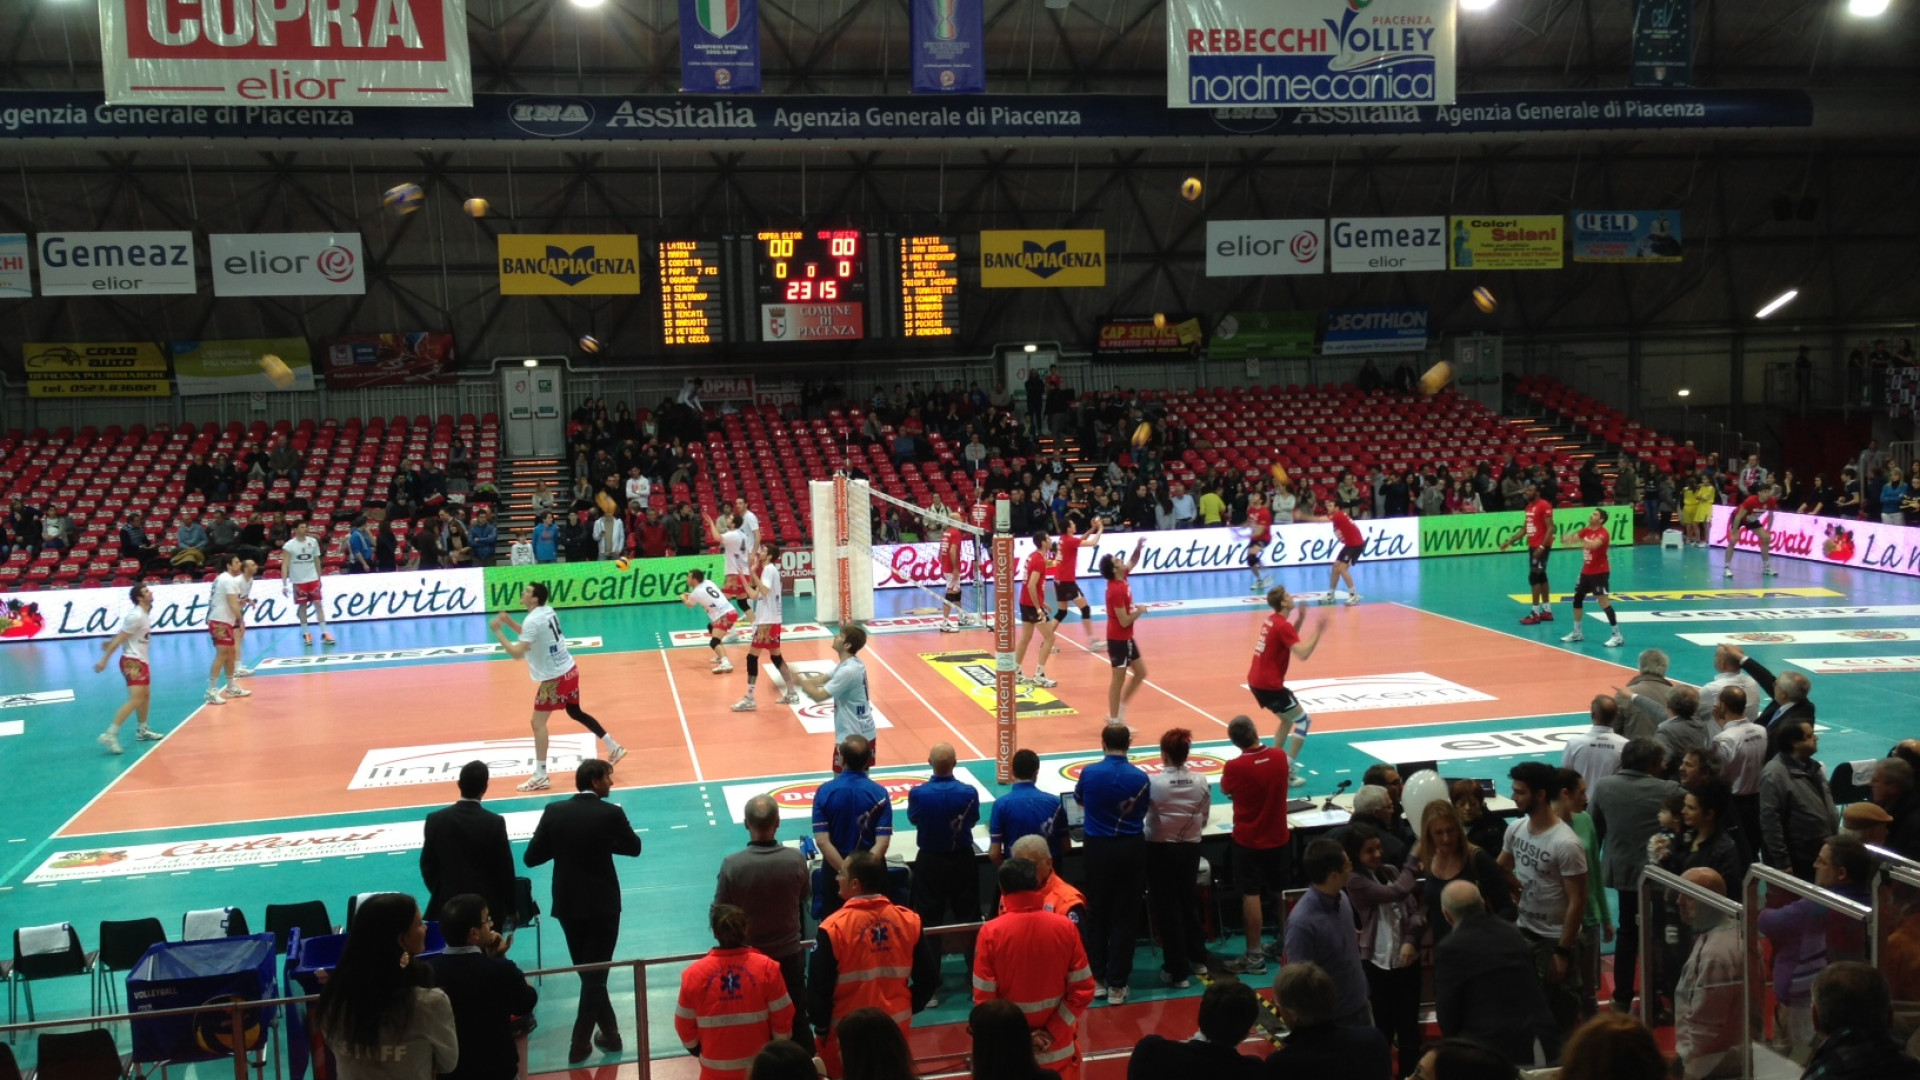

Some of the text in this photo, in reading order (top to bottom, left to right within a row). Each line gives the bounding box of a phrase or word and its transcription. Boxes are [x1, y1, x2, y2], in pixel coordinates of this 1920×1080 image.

[1372, 16, 1433, 26] PIACENZA
[1187, 8, 1435, 56] REBECCHI VOLLEY
[237, 69, 346, 100] elior
[1191, 63, 1433, 102] nordmeccanica
[0, 103, 355, 131] genzia Generale di Piacenza
[513, 102, 588, 122] INA
[606, 101, 757, 128] Assitalia
[773, 105, 1081, 132] Agenzia Generale di Piacenza
[1436, 99, 1706, 126] Agenzia Generale di Piacenza
[1471, 220, 1518, 228] Colori
[1333, 221, 1442, 249] Gemeaz
[42, 237, 189, 268] Gemeaz
[769, 239, 794, 257] 00
[831, 238, 855, 256] 00
[1216, 234, 1285, 258] elior
[224, 251, 310, 275] elior
[502, 257, 637, 275] BANCAPIACENZA
[839, 260, 850, 277] 0
[983, 251, 1102, 269] BANCAPIACENZA
[1368, 255, 1407, 268] elior
[775, 262, 787, 279] 0
[807, 265, 815, 278] 0
[92, 279, 143, 291] elior
[787, 280, 837, 300] 23 15
[800, 305, 851, 317] COMUNE
[820, 316, 832, 326] DI
[1328, 310, 1428, 331] DECATHLON
[798, 326, 856, 337] PIACENZA
[1101, 326, 1127, 339] CAP
[1298, 527, 1413, 562] serita
[1862, 533, 1903, 568] La
[998, 543, 1008, 594] linkem
[705, 586, 720, 600] 6
[58, 601, 119, 633] La
[332, 577, 476, 619] servita
[1650, 606, 1880, 621] Gemeaz
[998, 597, 1008, 649] linkem
[998, 673, 1009, 726] linkem
[1299, 686, 1467, 707] inkem
[1440, 732, 1588, 752] elio
[998, 728, 1009, 780] linkem
[1511, 835, 1551, 863] MUSIC
[133, 986, 178, 1000] VOLLEYBALL
